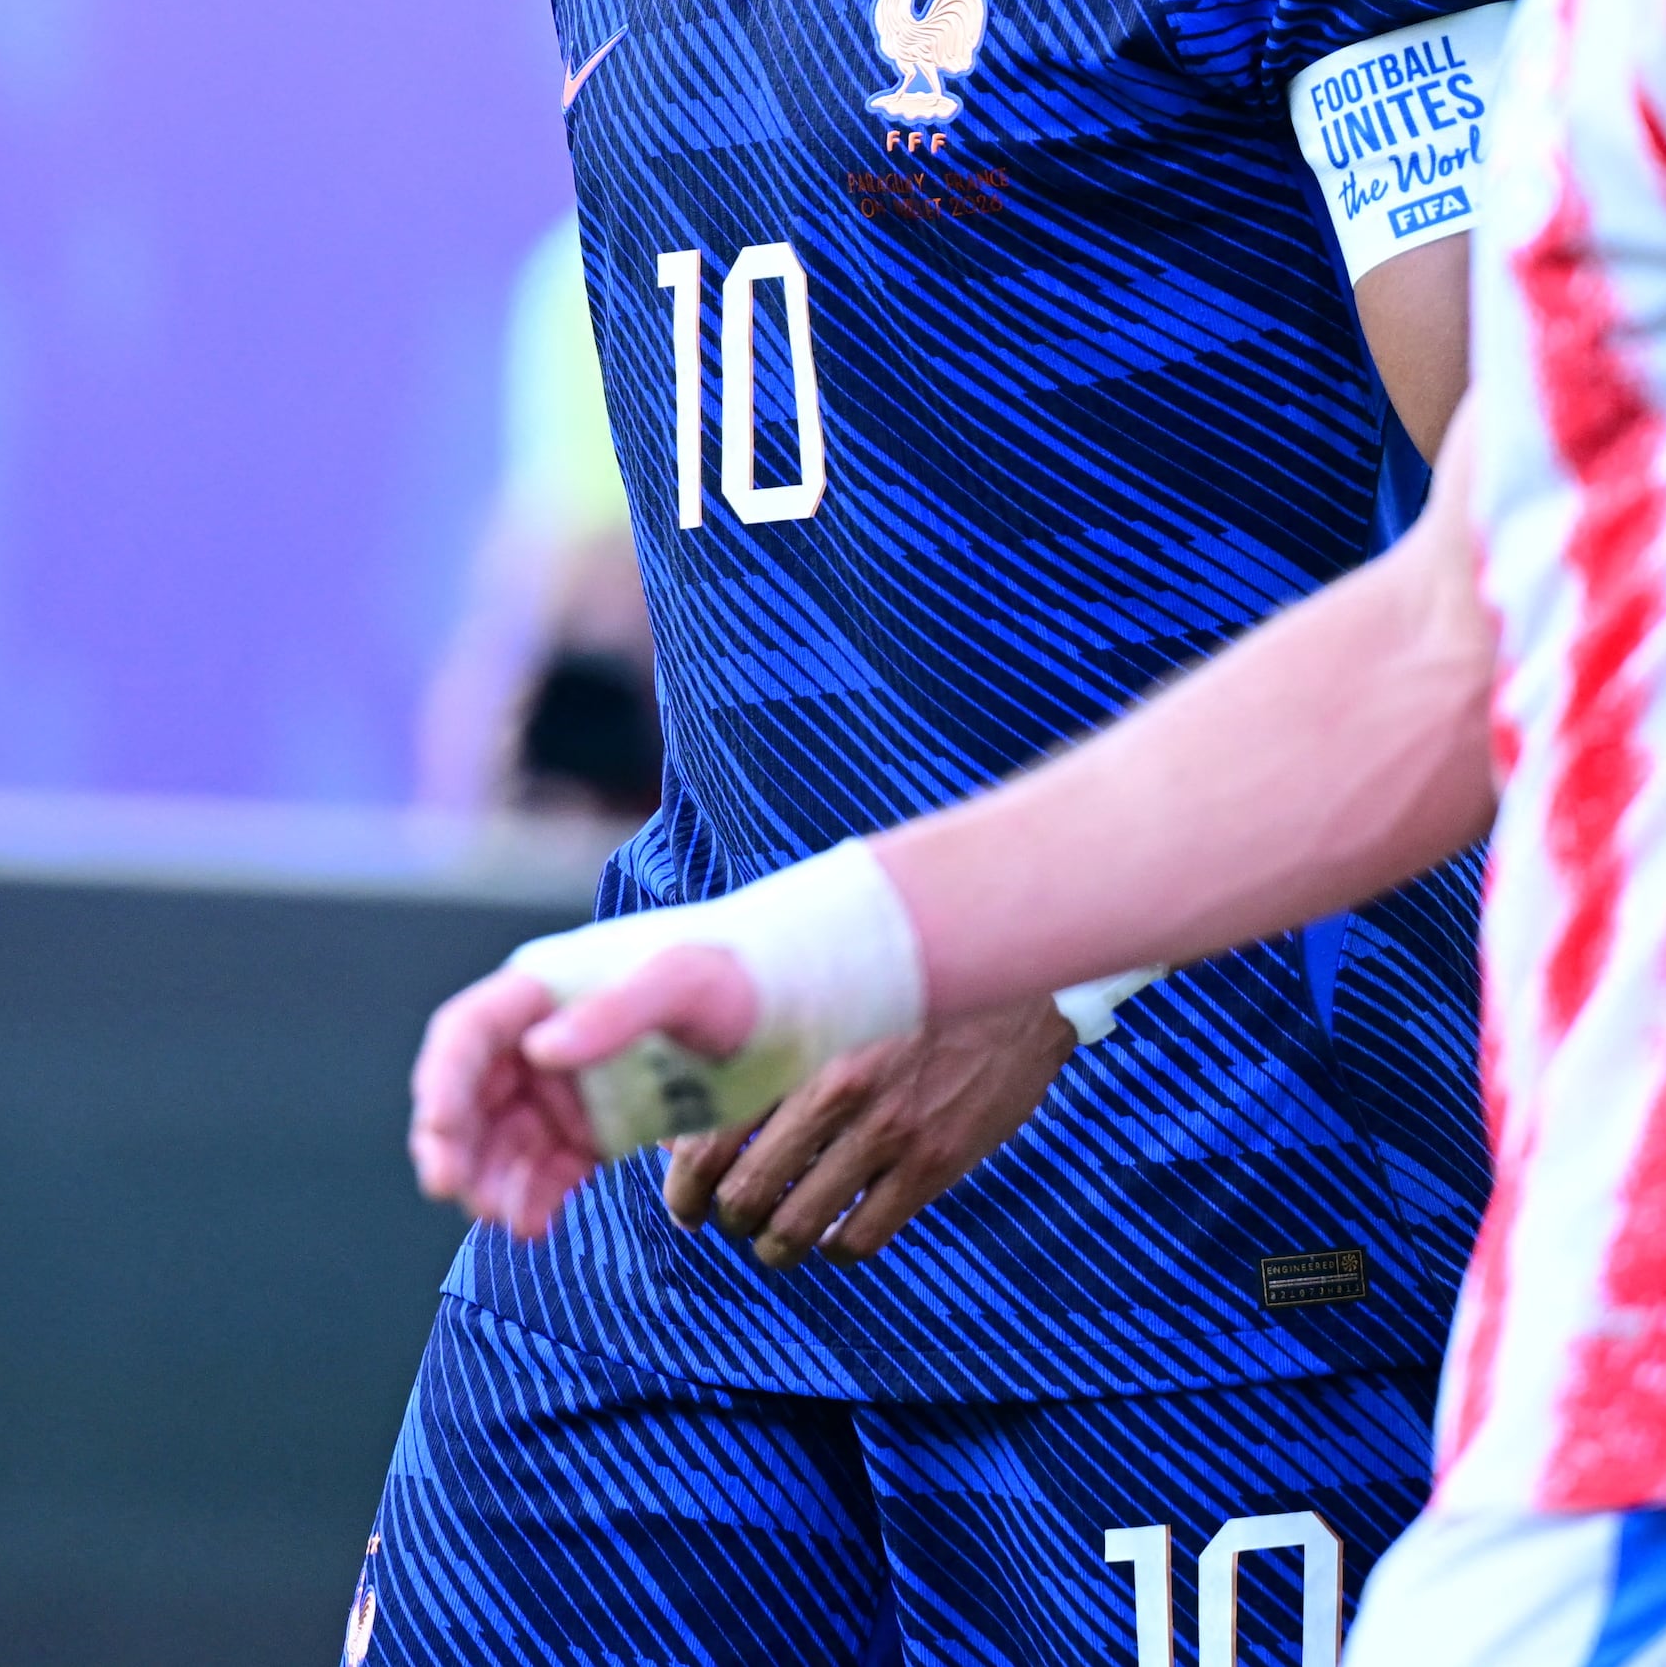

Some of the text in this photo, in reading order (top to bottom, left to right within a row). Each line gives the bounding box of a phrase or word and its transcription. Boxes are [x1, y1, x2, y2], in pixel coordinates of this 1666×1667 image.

[1310, 35, 1466, 121] FOOTBALL
[1321, 72, 1485, 170] UNITES
[886, 130, 947, 155] FFF
[1338, 123, 1486, 221] the Worl
[1394, 193, 1466, 233] FIFA
[657, 241, 827, 530] 10
[1266, 1260, 1335, 1275] ENGINEERED
